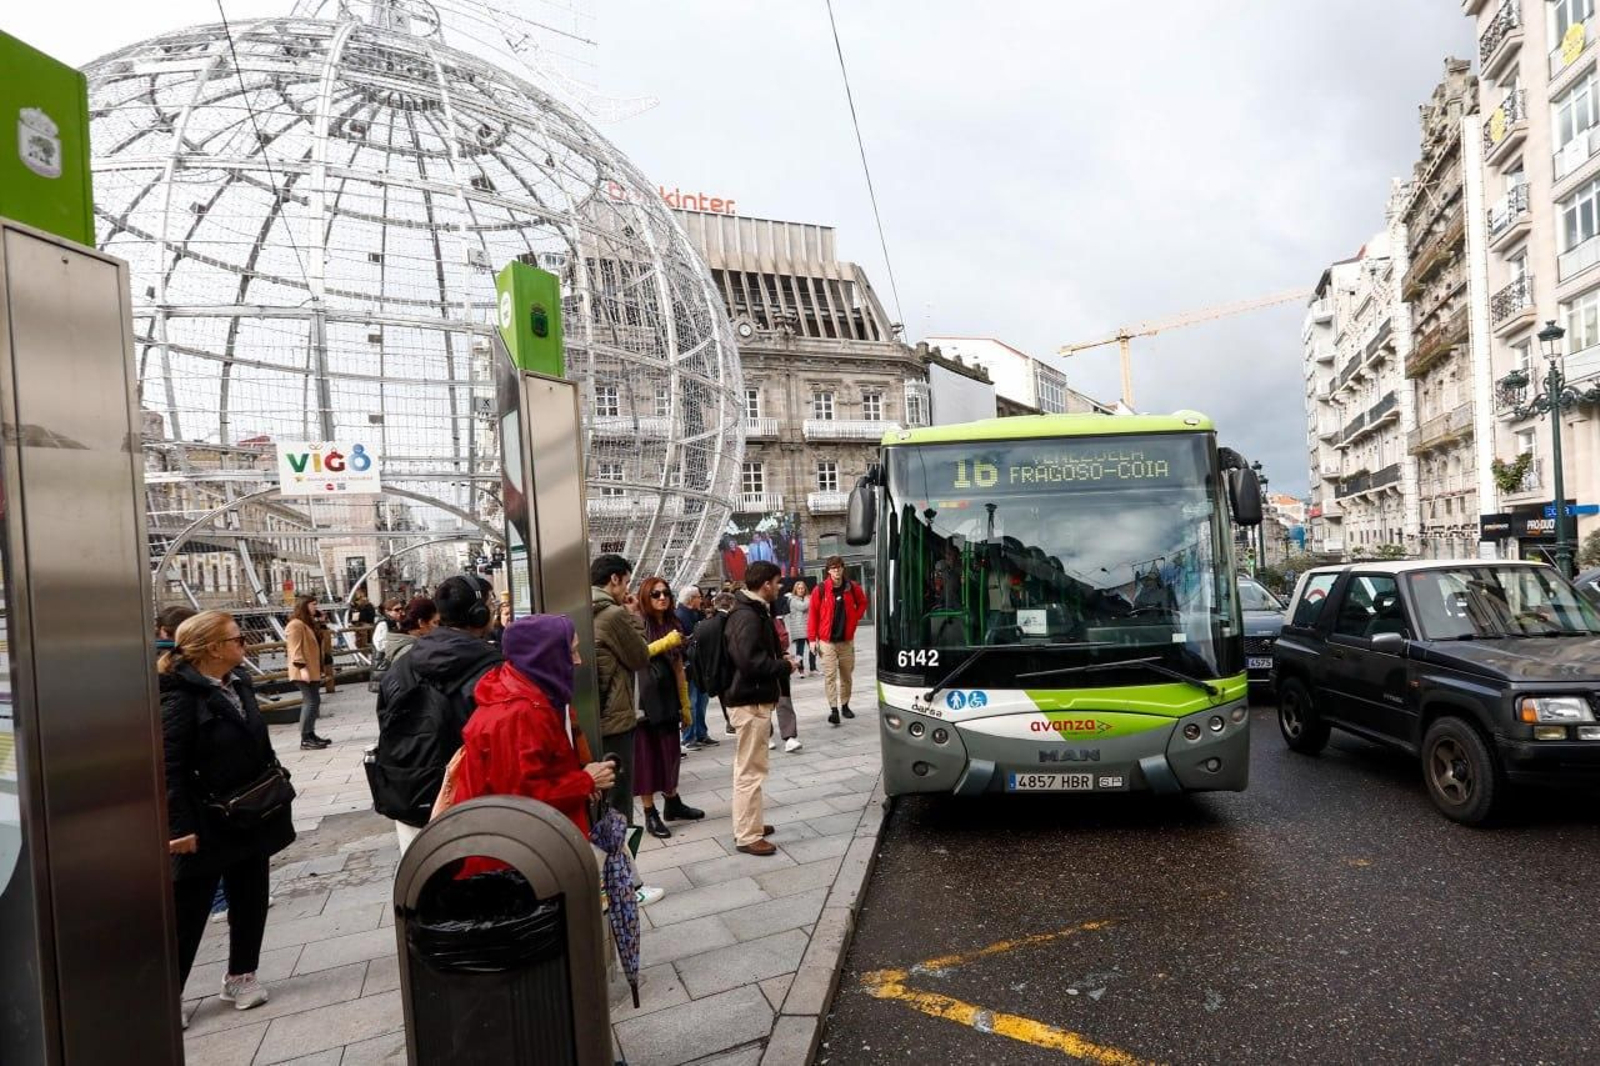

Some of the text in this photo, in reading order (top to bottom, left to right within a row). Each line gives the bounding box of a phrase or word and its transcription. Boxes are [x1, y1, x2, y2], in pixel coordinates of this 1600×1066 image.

[608, 180, 736, 214] bkinter.
[954, 459, 1169, 488] 16 FRAGOSO-COIA
[898, 649, 939, 667] 6142
[1031, 720, 1095, 732] avanza
[1039, 749, 1100, 762] MAN
[1019, 775, 1090, 788] 4857 HBR
